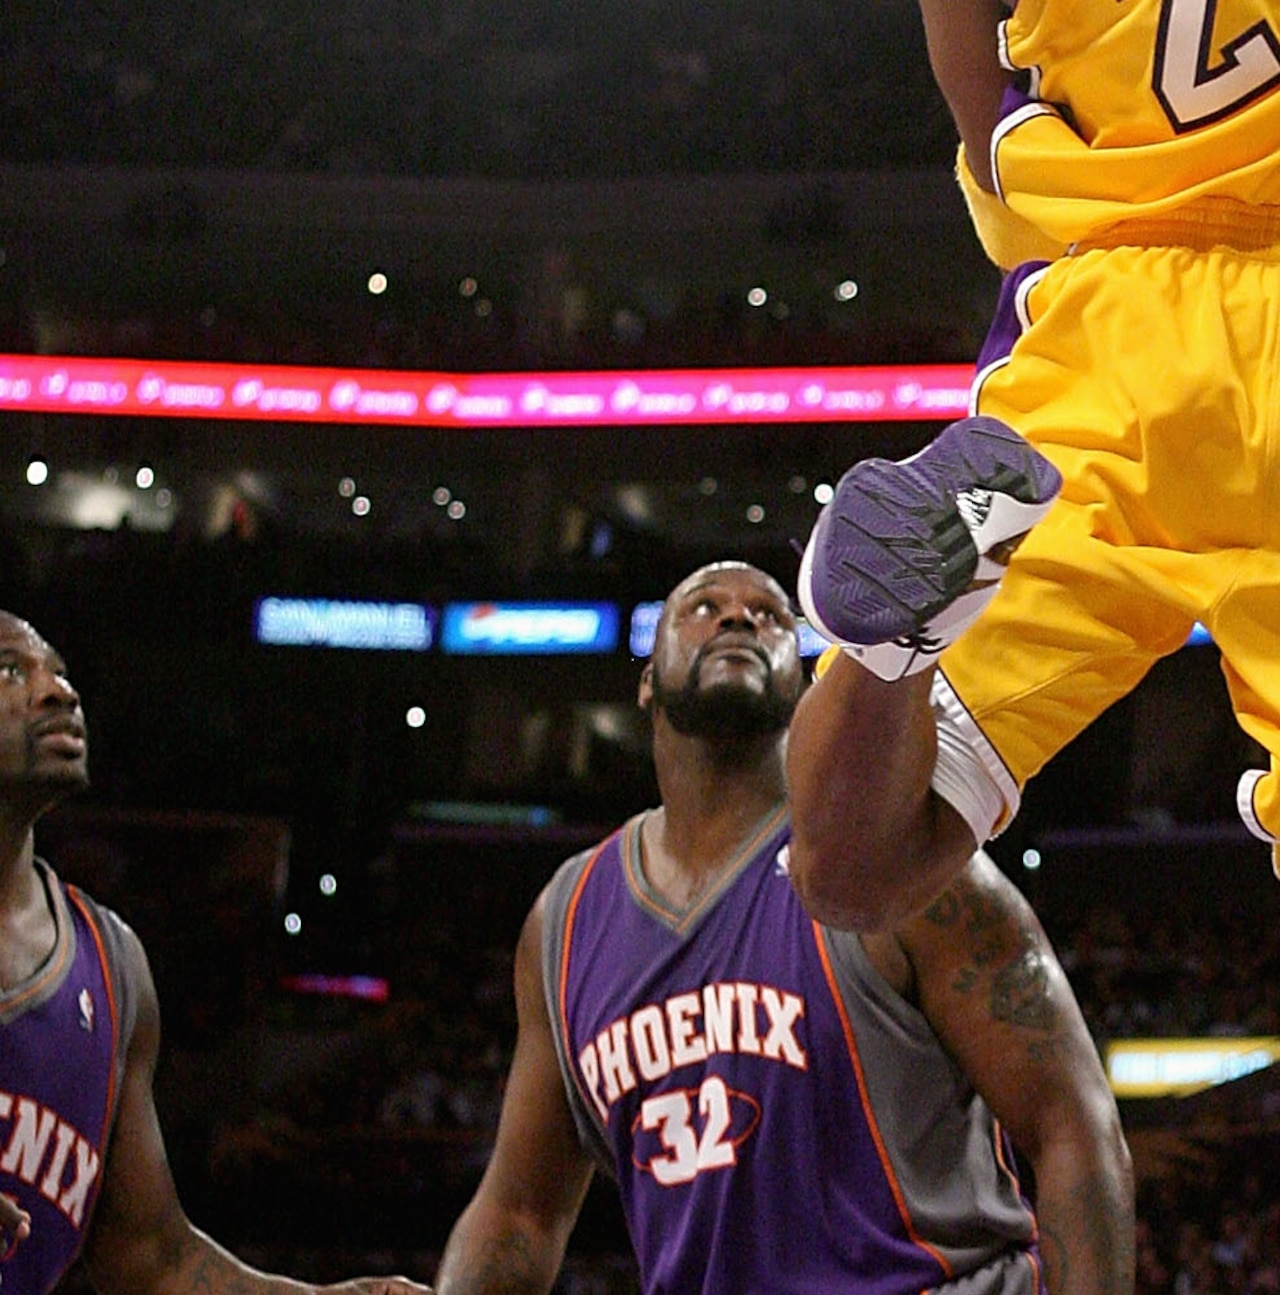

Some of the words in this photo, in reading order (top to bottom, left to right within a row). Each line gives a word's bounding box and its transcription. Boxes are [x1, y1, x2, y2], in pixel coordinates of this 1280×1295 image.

[577, 980, 808, 1124] PHOENIX
[0, 1089, 100, 1231] NIX
[638, 1074, 739, 1189] 32
